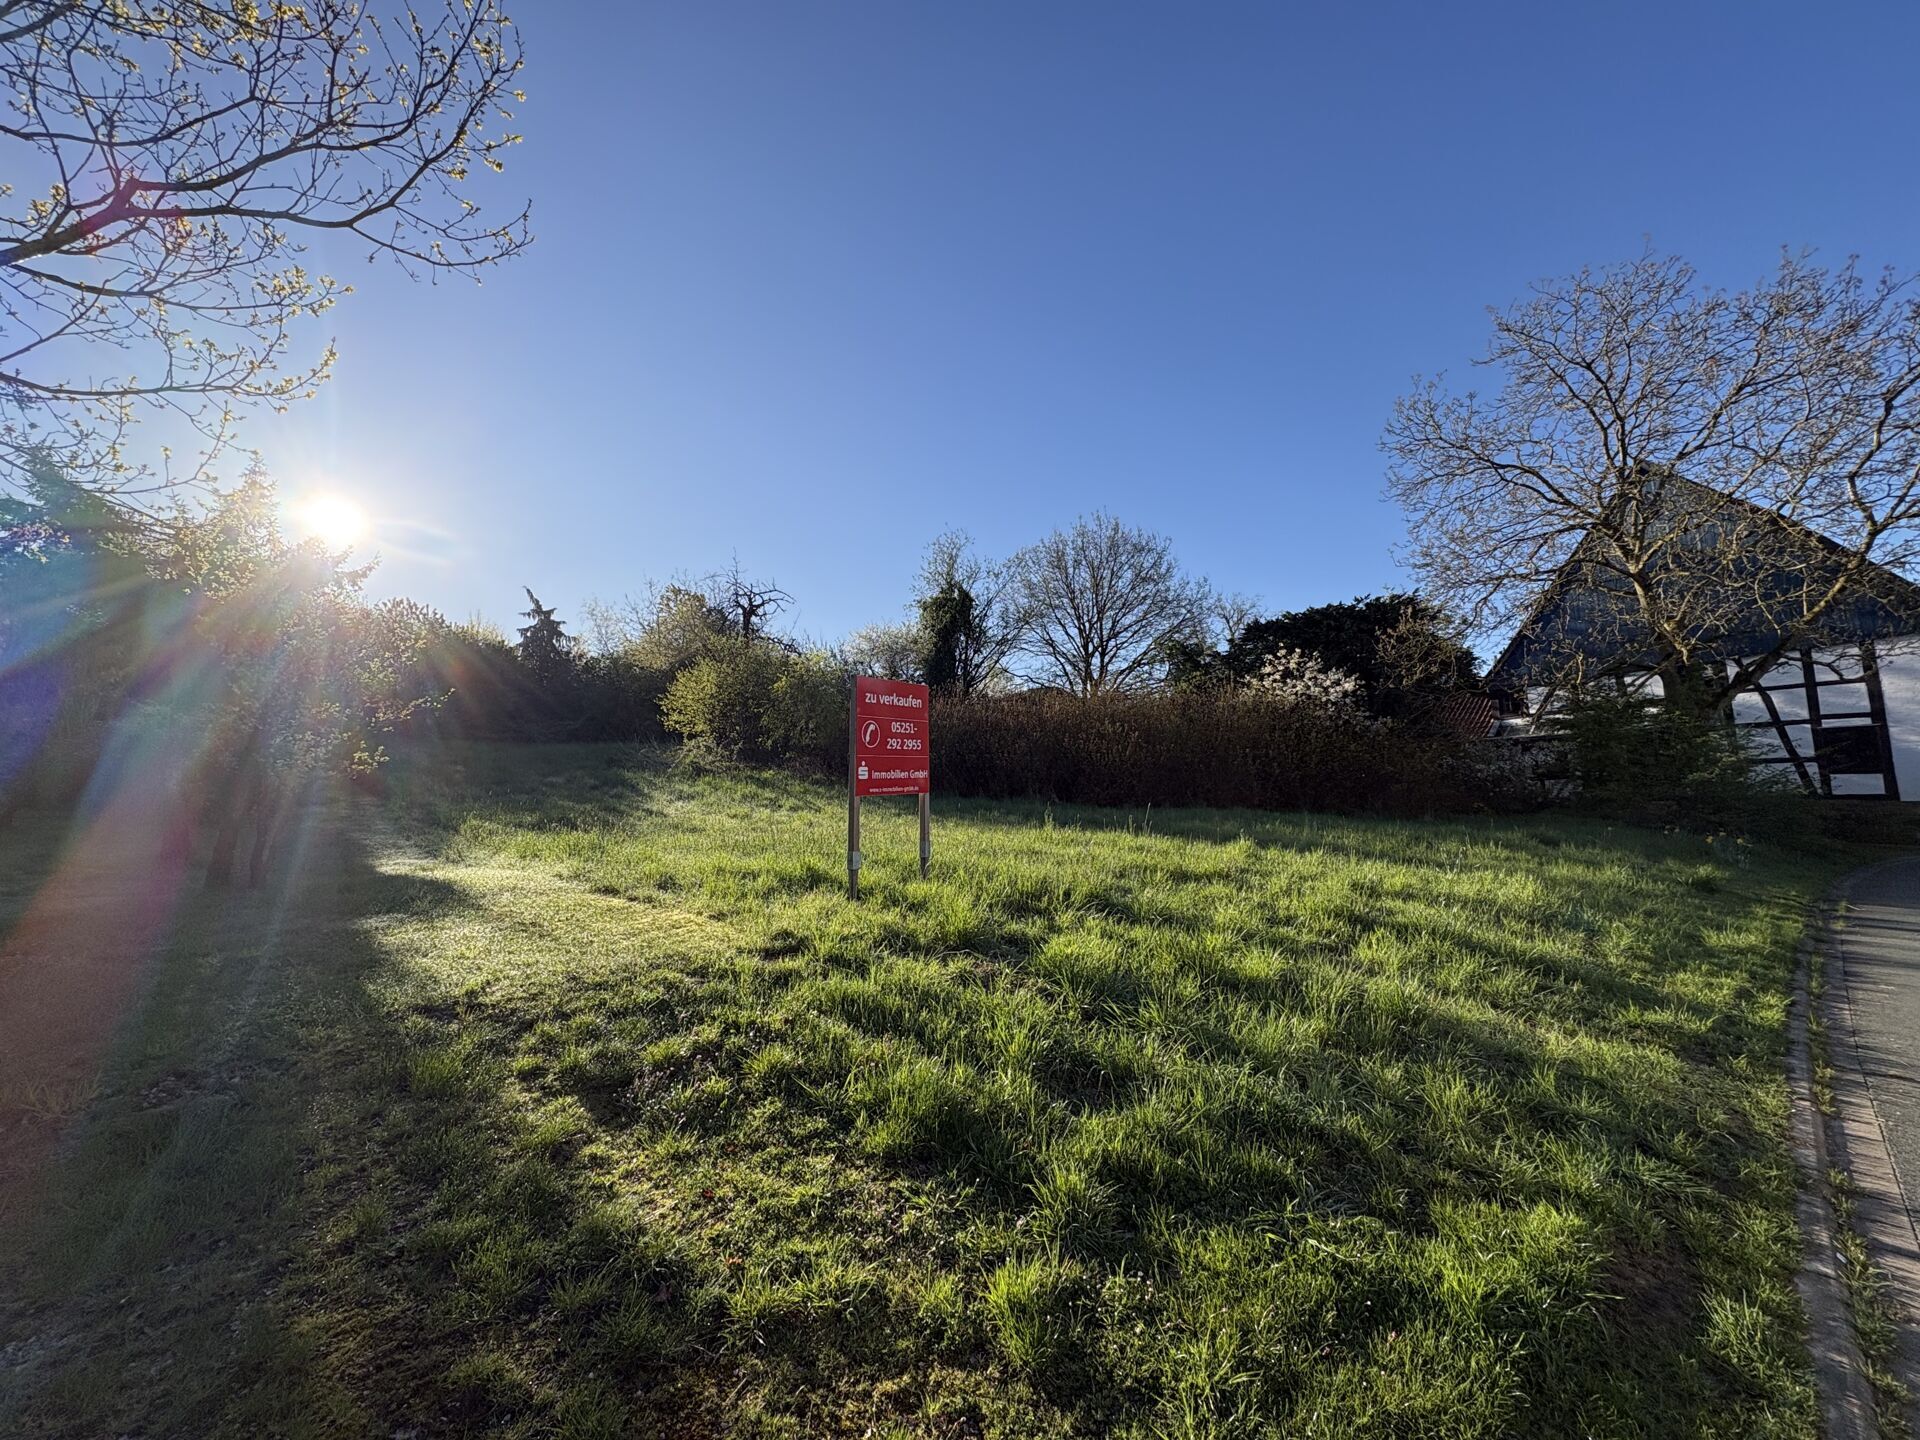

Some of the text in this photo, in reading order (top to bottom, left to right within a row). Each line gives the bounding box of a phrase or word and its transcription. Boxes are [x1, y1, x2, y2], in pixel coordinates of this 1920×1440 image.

[865, 693, 922, 708] zu verkaufen
[891, 722, 918, 734] 05251-
[887, 738, 922, 750] 292 2955
[871, 769, 909, 779] Immobilien
[909, 769, 928, 779] GmbH
